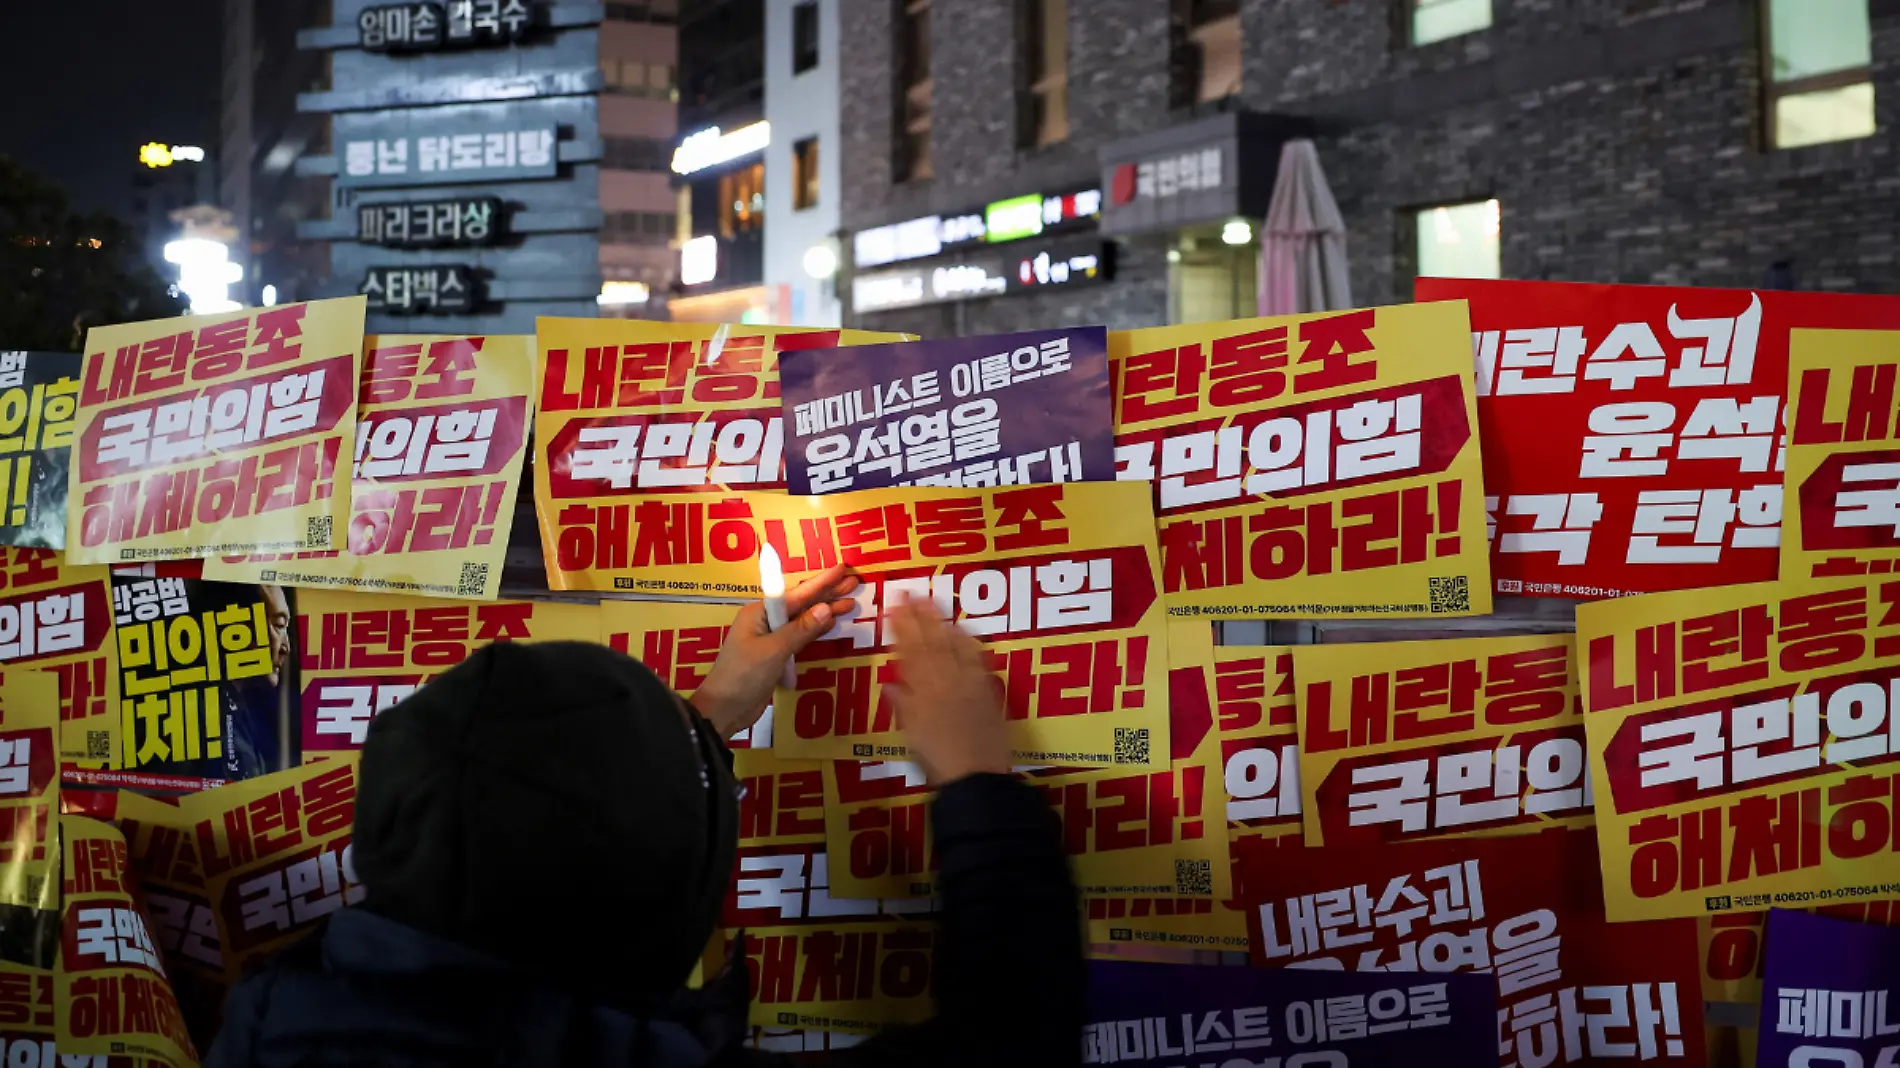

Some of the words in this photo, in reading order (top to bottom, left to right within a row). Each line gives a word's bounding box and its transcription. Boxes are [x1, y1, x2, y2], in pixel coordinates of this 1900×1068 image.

[346, 137, 409, 176] 풍년
[417, 129, 553, 172] 닭도리탕
[361, 202, 491, 242] 파리크라상
[363, 268, 465, 308] 스타벅스
[79, 303, 307, 408] 내란동조
[794, 370, 942, 437] 페미니스트
[950, 337, 1072, 397] 이름으로
[1108, 308, 1377, 424] 란동조
[97, 369, 326, 467] 국민의힘
[352, 408, 498, 478] 의힘
[805, 398, 1001, 494] 윤석열을
[1579, 396, 1788, 478] 윤석
[1792, 364, 1900, 445] 내
[81, 436, 342, 547] 해체하라!
[571, 417, 788, 490] 국민의
[764, 484, 1070, 573] 내란동조
[1486, 493, 1604, 566] 각
[118, 602, 274, 697] 민의힘
[1305, 645, 1583, 753] 내란동
[1259, 858, 1486, 959] 내란수괴
[1774, 884, 1879, 903] 406201-01-075064
[1285, 982, 1452, 1046] 이름으로
